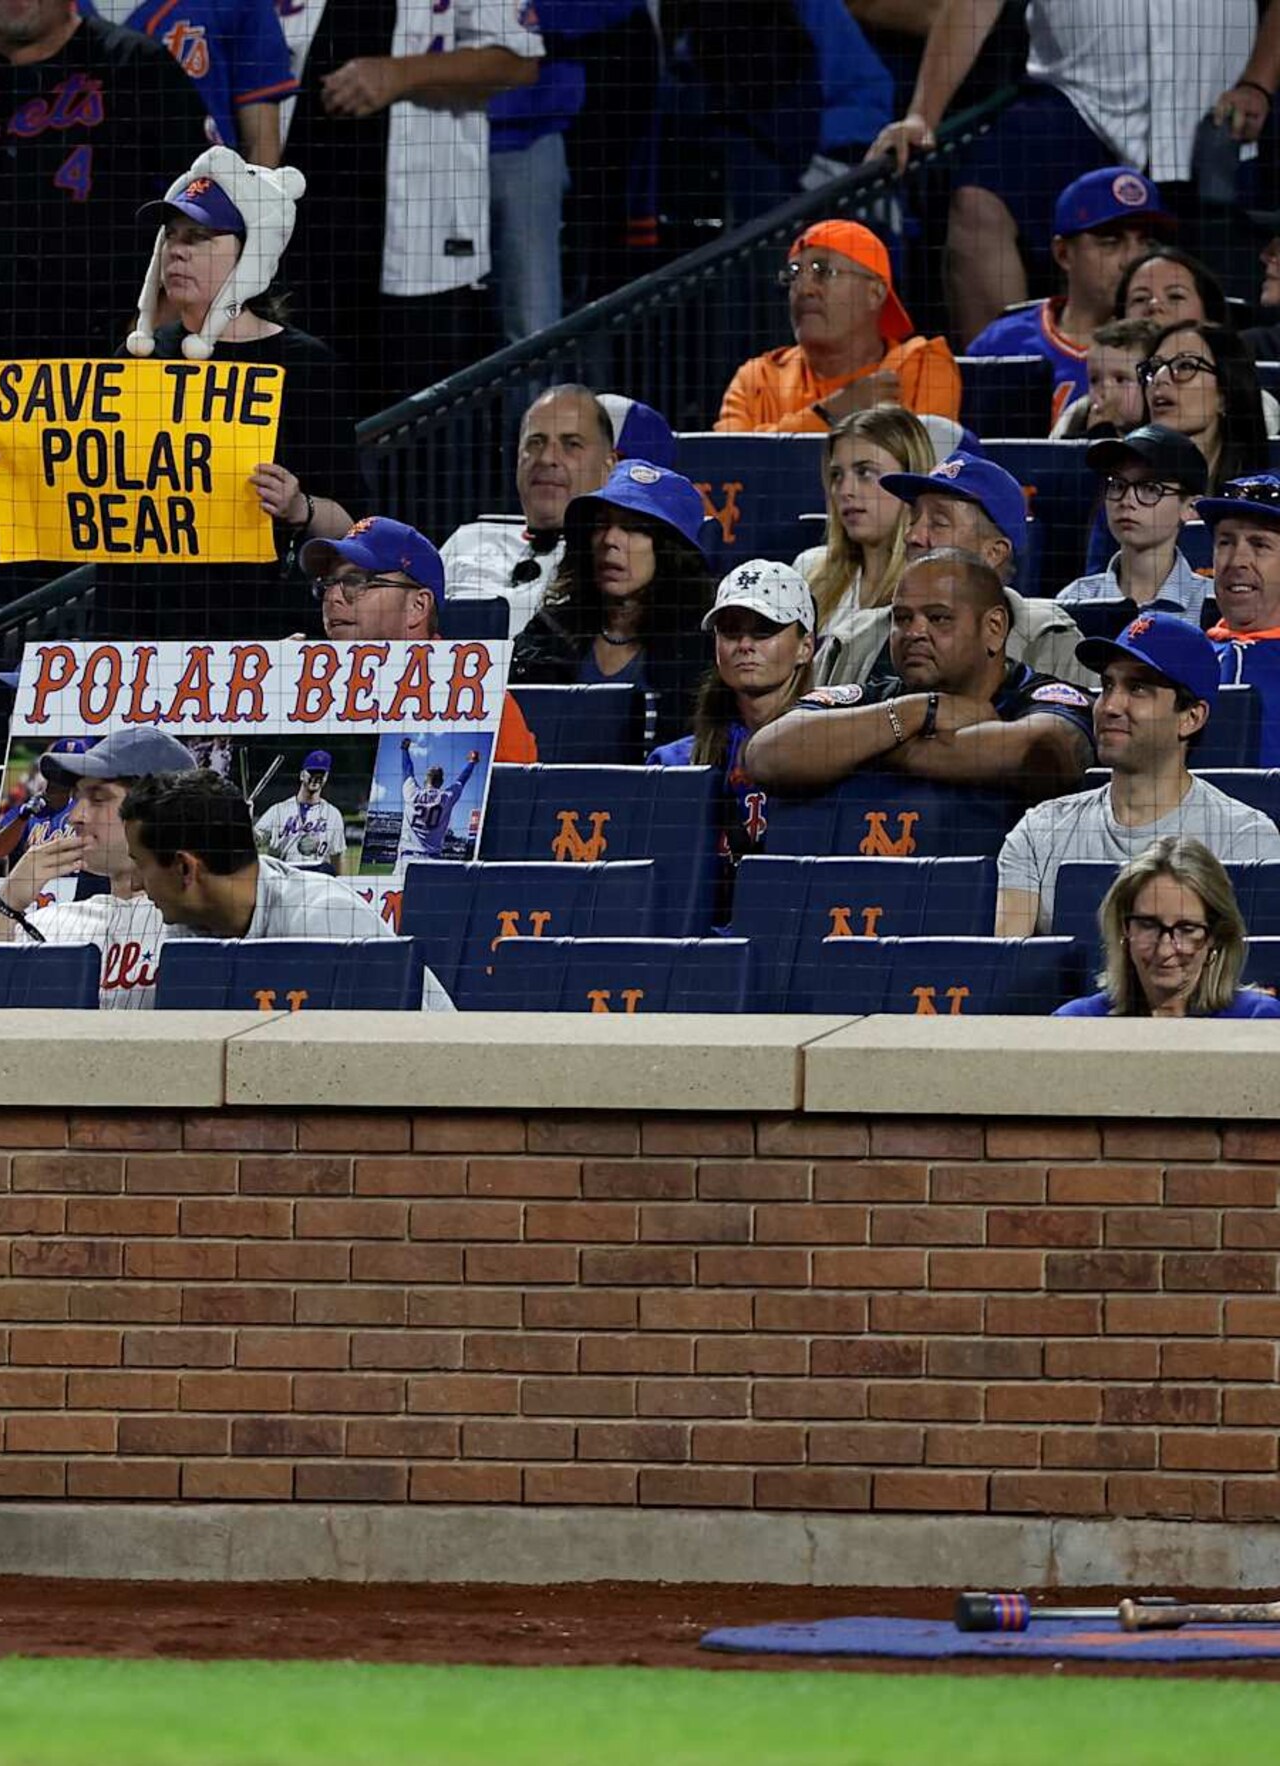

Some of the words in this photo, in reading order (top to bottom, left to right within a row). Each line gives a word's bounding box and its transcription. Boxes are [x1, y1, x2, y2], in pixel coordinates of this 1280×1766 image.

[54, 145, 93, 202] 4
[164, 364, 278, 425] THE
[41, 428, 212, 493] POLAR
[67, 491, 199, 556] BEAR
[24, 643, 272, 726] POLAR
[287, 641, 494, 724] BEAR
[278, 815, 328, 840] Mets
[410, 804, 443, 829] 20
